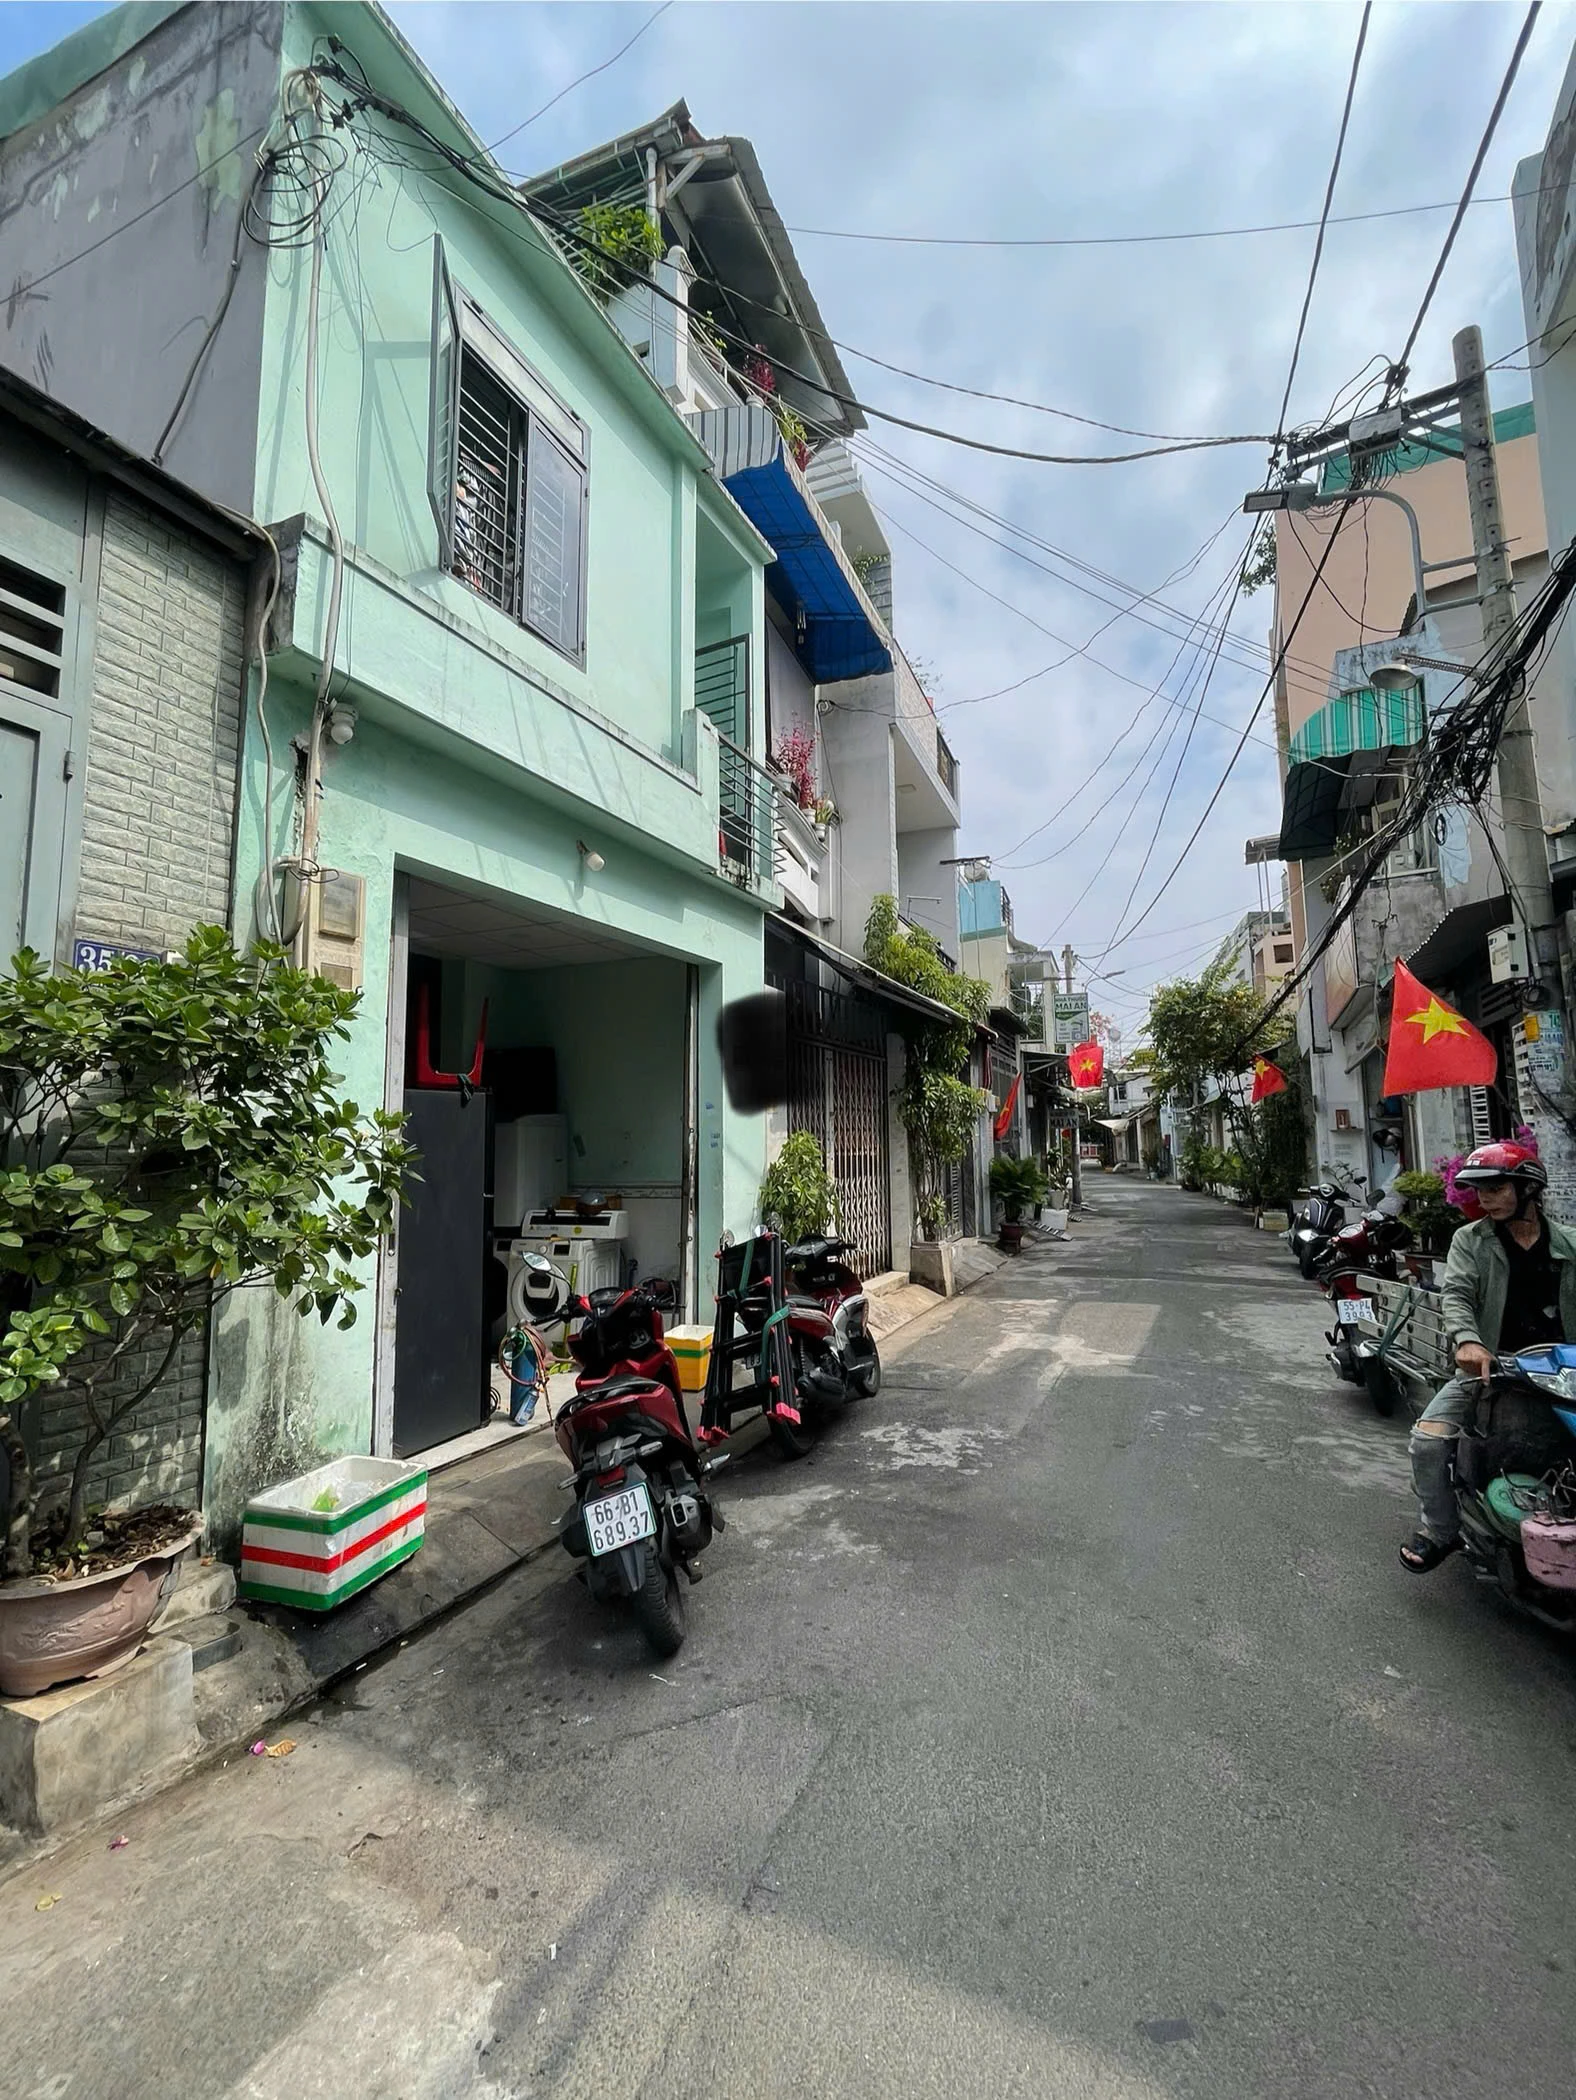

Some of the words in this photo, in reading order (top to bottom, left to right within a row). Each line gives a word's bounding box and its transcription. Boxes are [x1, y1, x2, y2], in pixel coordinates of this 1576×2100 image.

[1055, 1002, 1072, 1010] MAI
[1074, 1002, 1087, 1010] AN
[593, 1510, 648, 1550] 689.37
